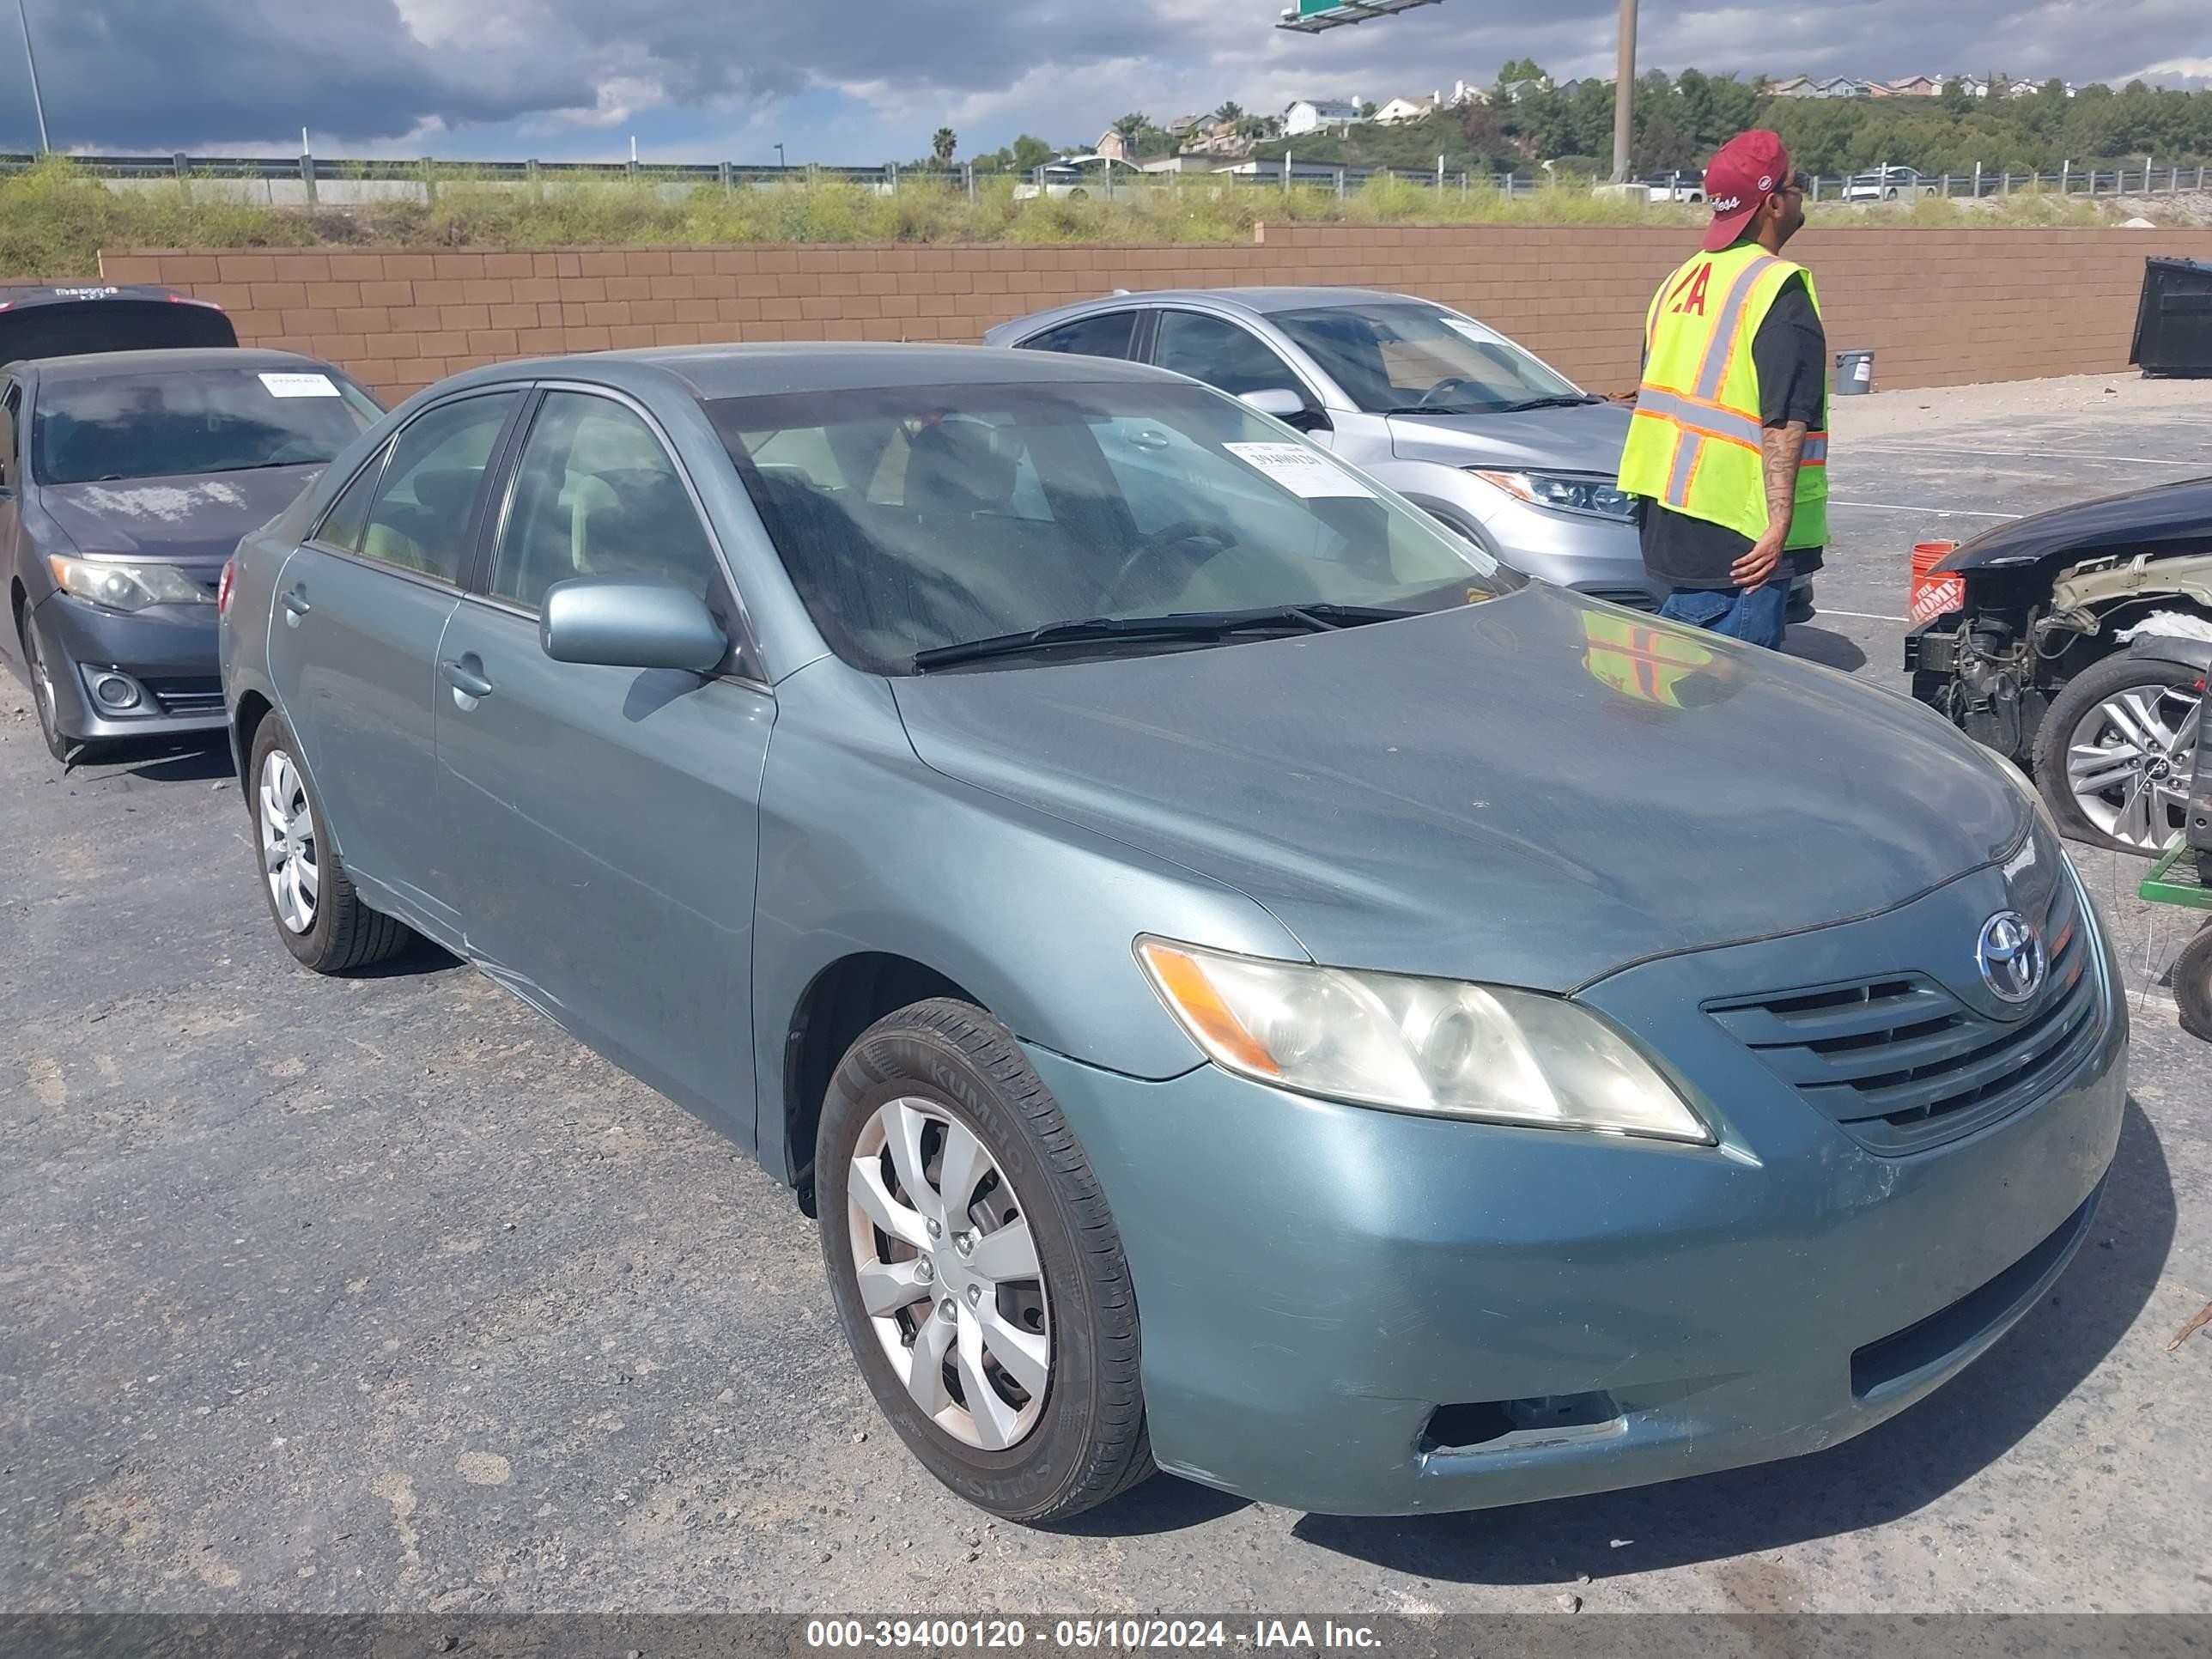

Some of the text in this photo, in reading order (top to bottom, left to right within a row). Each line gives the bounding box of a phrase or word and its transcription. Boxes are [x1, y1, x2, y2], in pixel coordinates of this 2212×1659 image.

[1911, 580, 1959, 622] HOME
[1915, 582, 1936, 600] THE
[930, 1060, 1024, 1176] KUMHO
